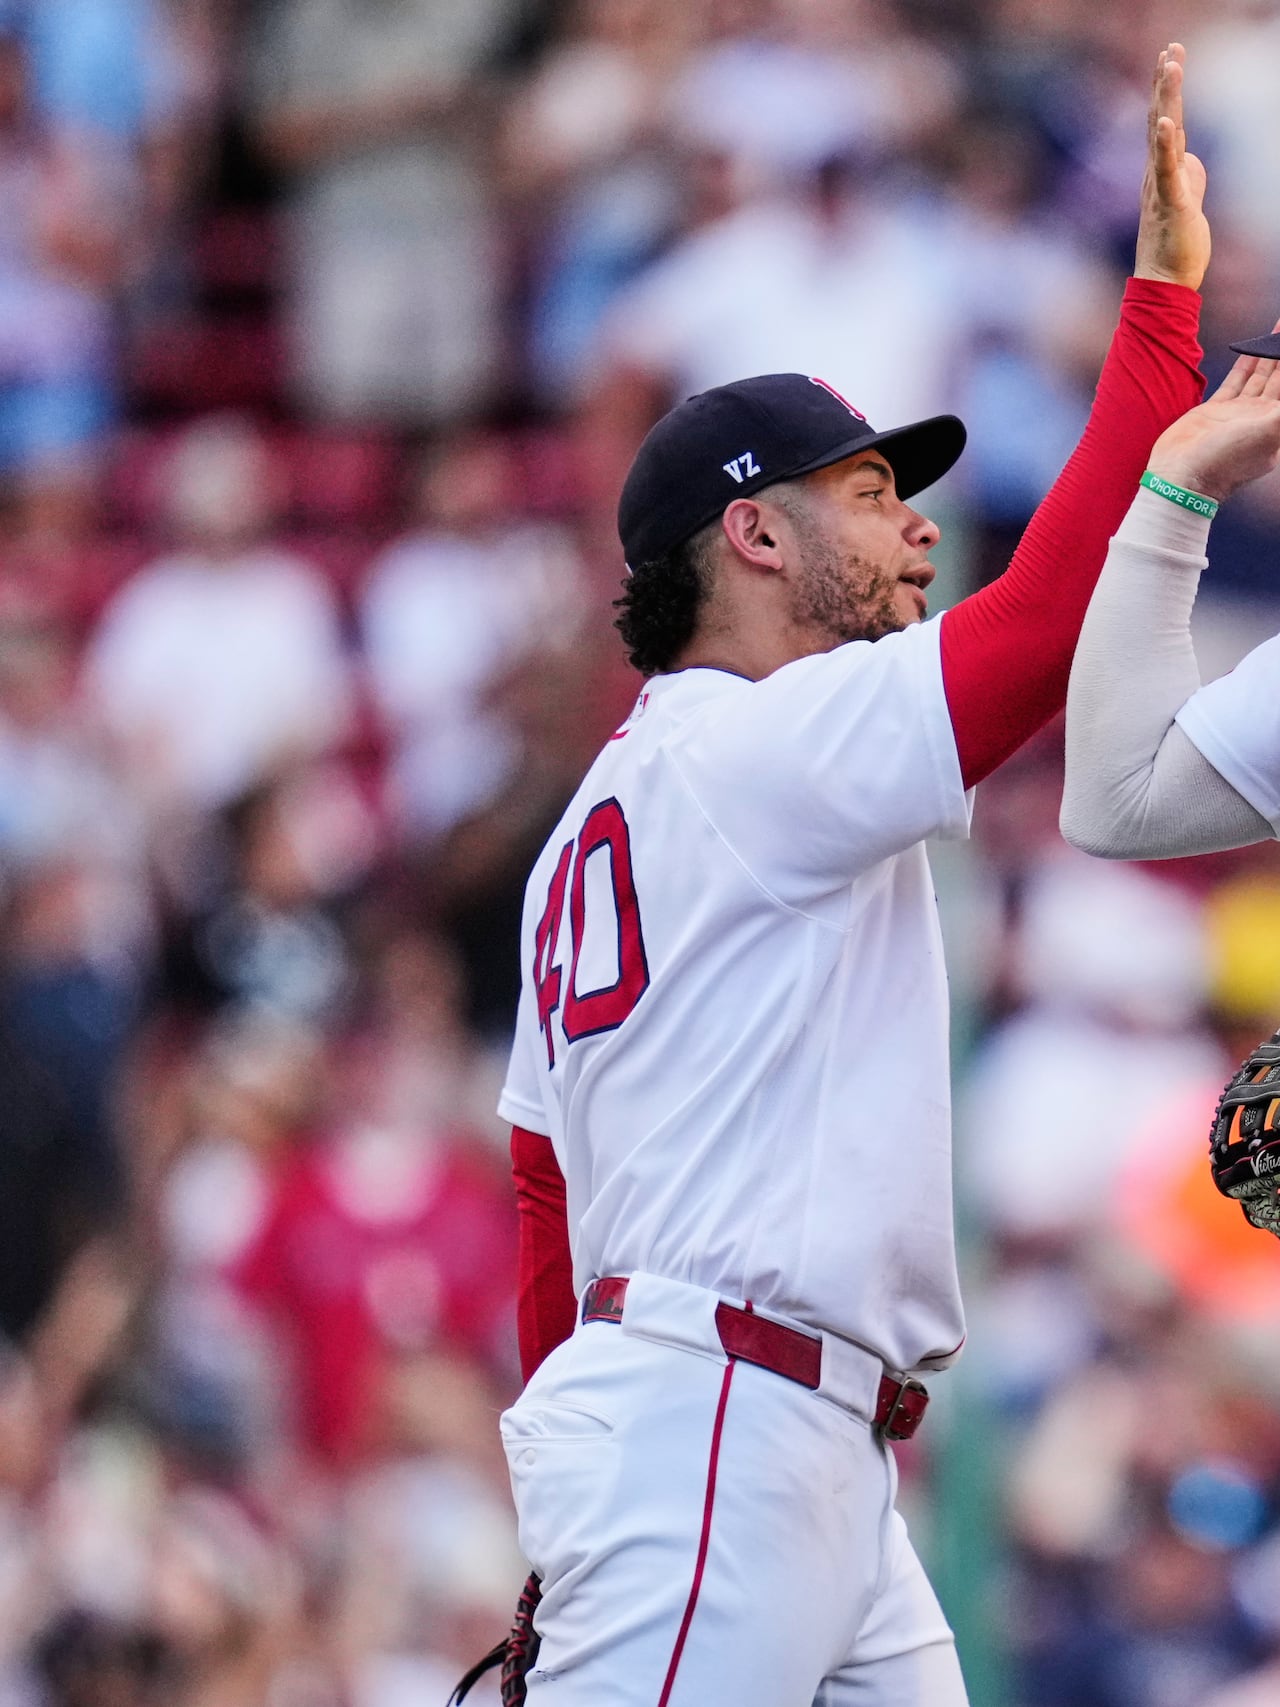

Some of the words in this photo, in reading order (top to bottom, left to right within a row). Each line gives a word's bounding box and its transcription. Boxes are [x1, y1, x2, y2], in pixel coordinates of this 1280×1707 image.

[722, 451, 762, 484] VZ
[1156, 481, 1187, 504] HOPE
[1185, 496, 1210, 515] FOR
[532, 794, 651, 1073] 40
